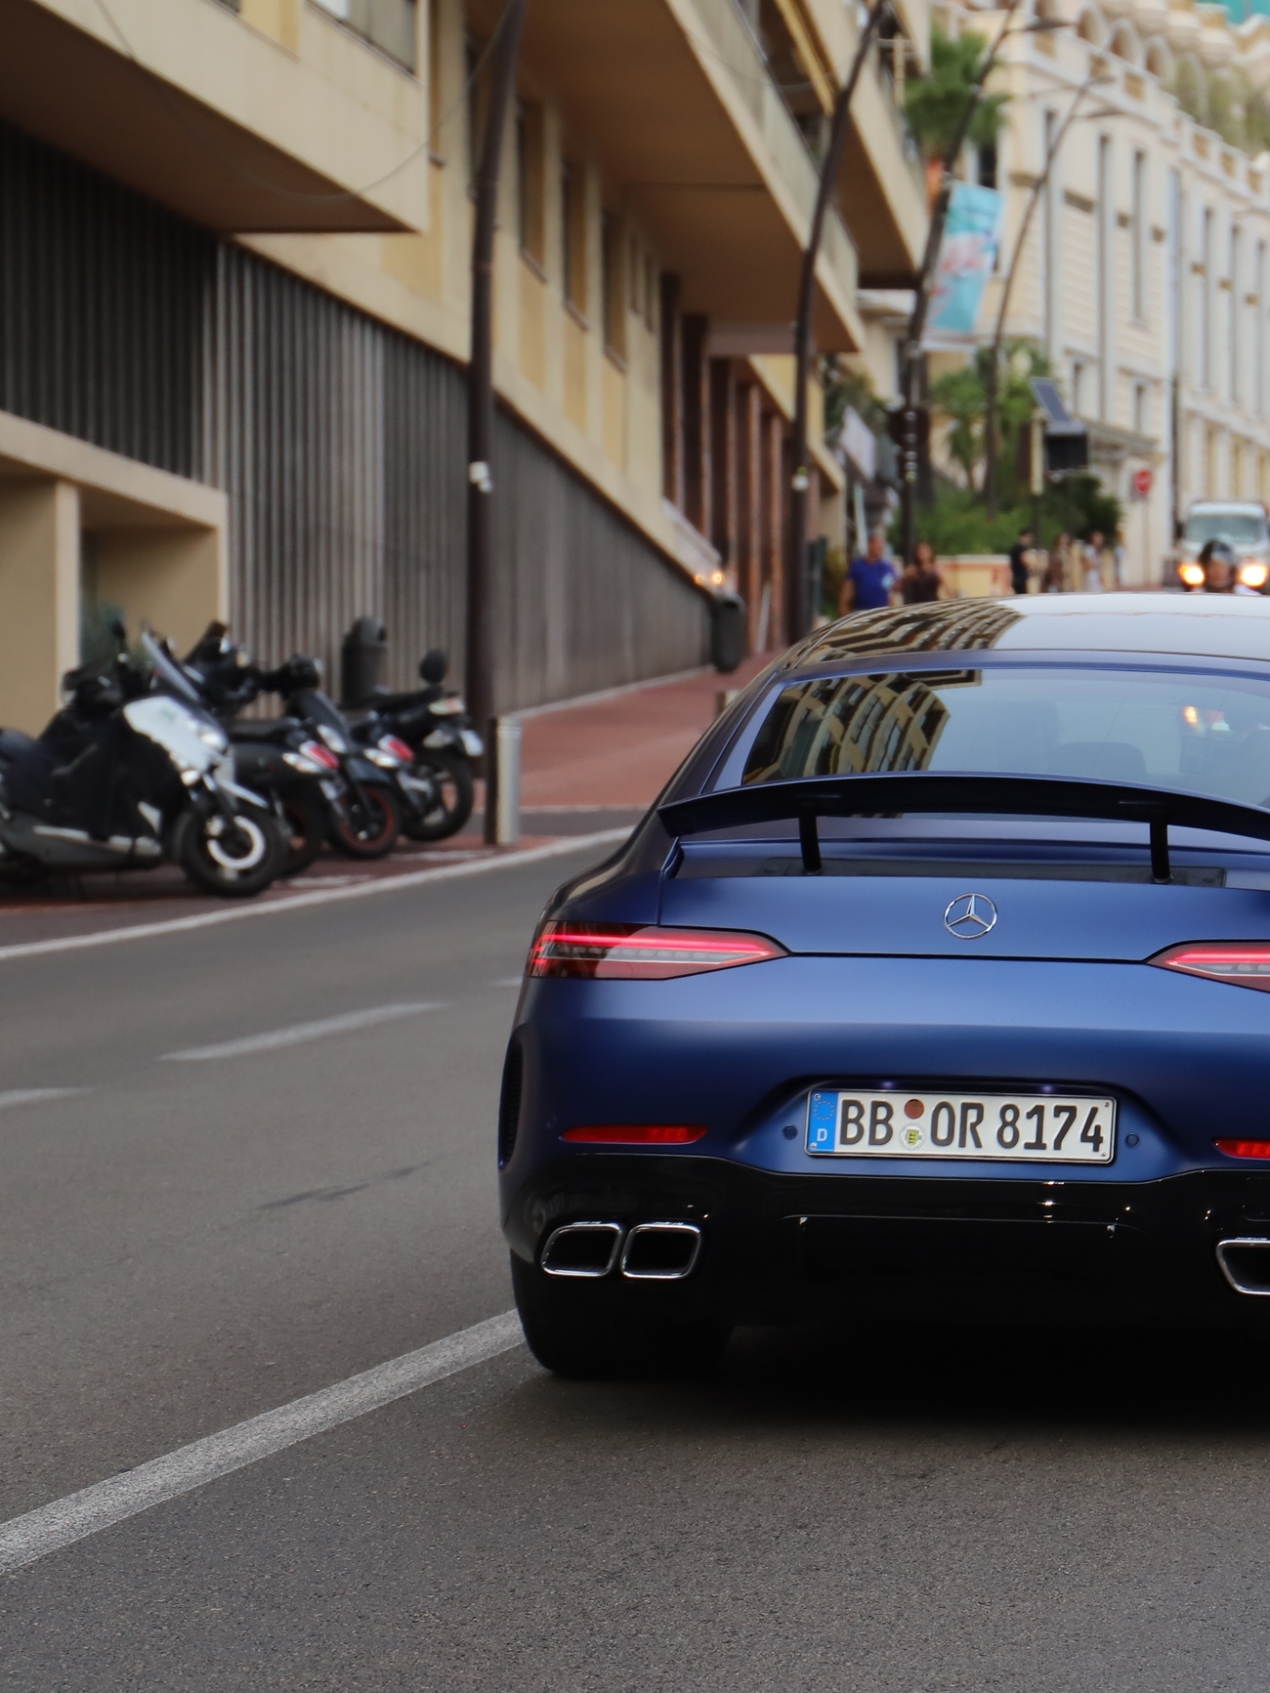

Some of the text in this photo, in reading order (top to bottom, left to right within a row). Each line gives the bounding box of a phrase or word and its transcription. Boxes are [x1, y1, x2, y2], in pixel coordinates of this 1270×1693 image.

[817, 1129, 828, 1142] D
[839, 1099, 1104, 1152] BB OR 8174
